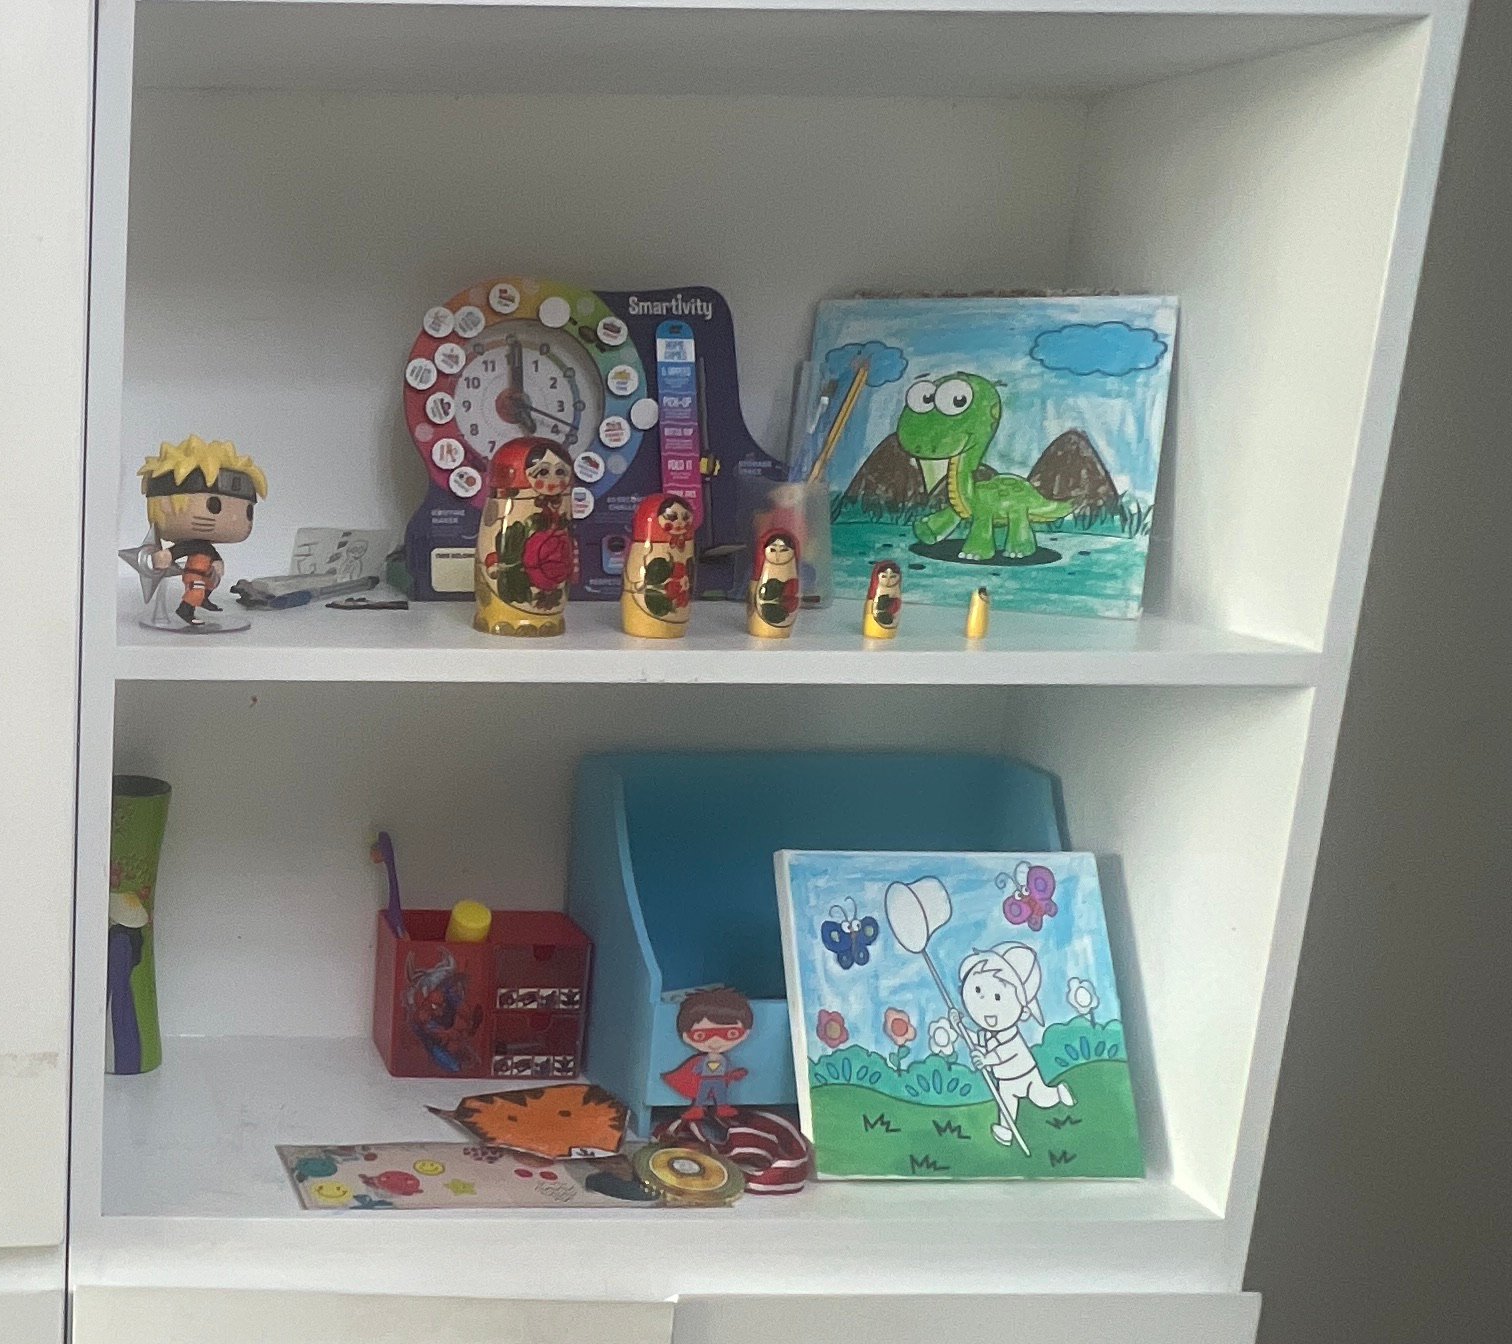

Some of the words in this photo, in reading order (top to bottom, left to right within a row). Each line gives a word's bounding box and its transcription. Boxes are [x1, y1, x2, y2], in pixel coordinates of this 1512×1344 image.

[629, 294, 712, 320] Smartivity
[482, 359, 496, 372] 11
[532, 359, 539, 372] 1
[464, 376, 481, 389] 10
[549, 376, 558, 389] 2
[462, 400, 472, 413] 9
[557, 400, 565, 413] 3
[469, 423, 479, 436] 8
[488, 440, 496, 453] 7
